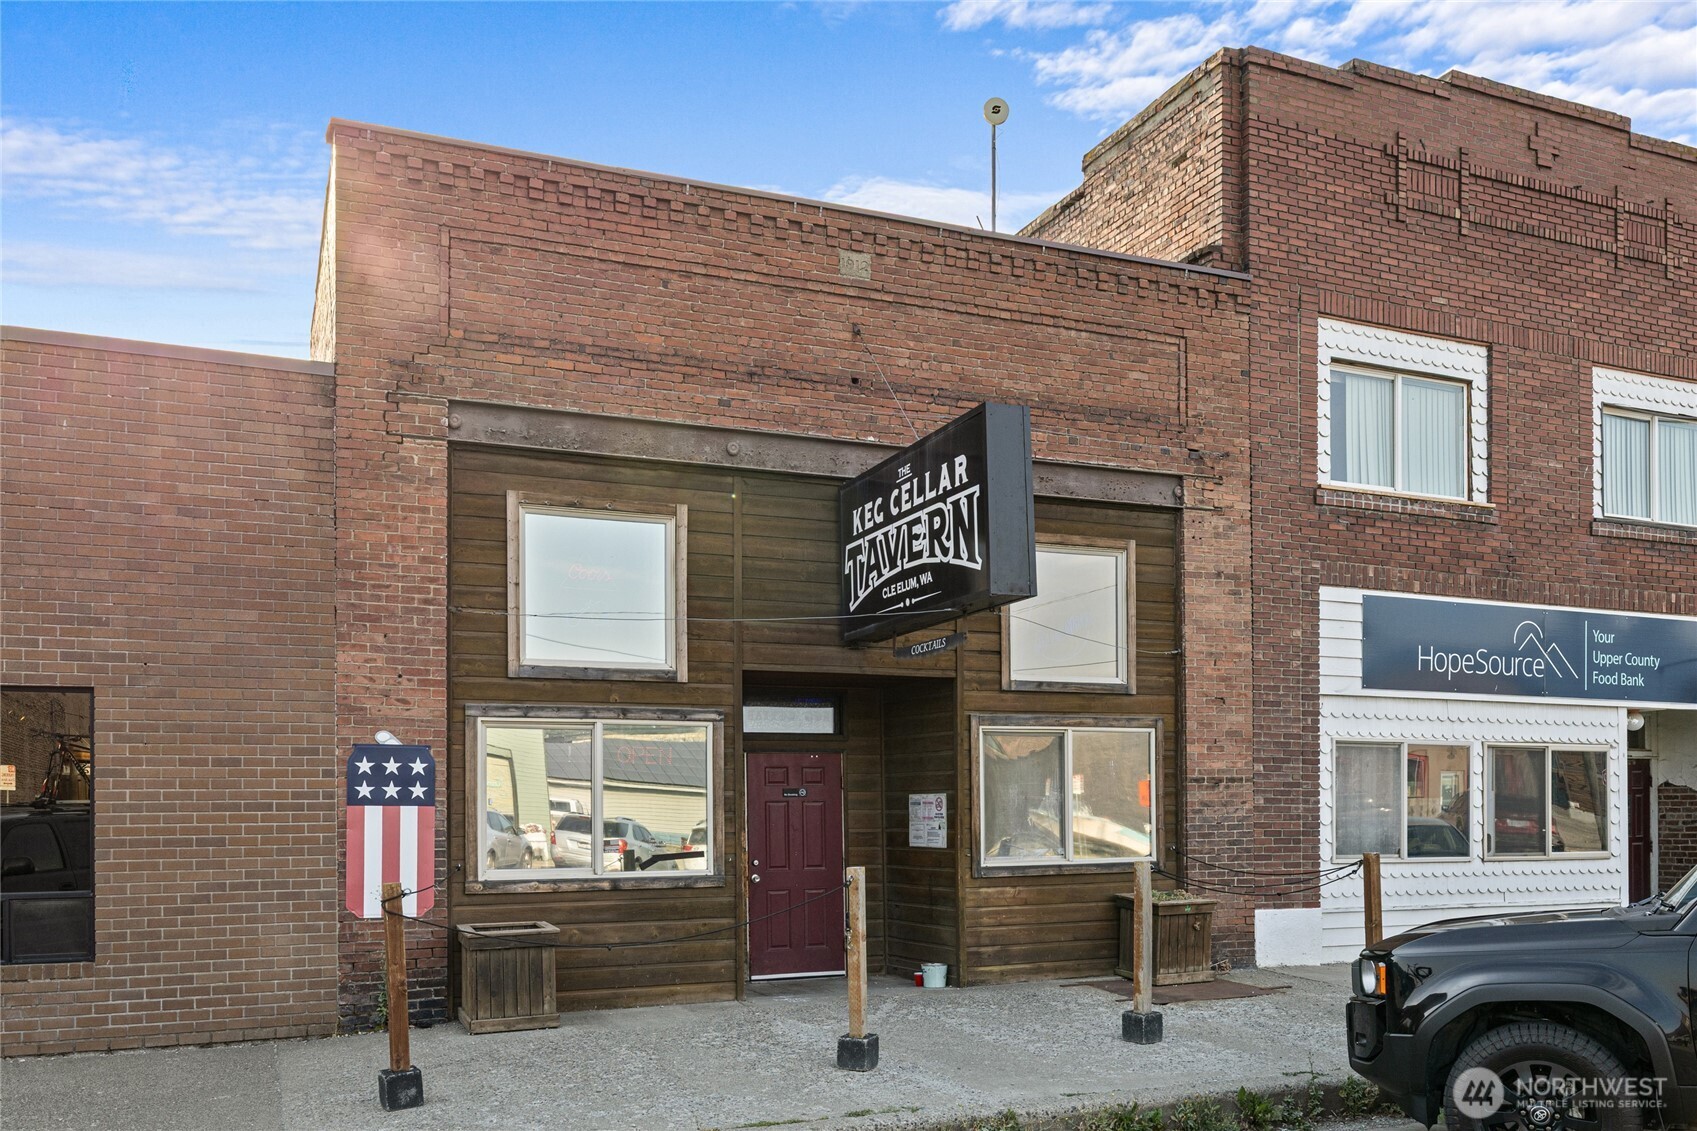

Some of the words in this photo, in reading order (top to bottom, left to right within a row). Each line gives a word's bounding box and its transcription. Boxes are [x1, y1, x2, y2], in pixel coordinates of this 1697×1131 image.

[898, 463, 911, 478] THE
[890, 454, 969, 516] CELLAR
[844, 484, 983, 613] TAVERN
[882, 583, 896, 599] CLE
[897, 577, 919, 594] ELUM,
[920, 571, 933, 585] WA
[911, 637, 947, 655] COCKTAILS
[1592, 629, 1615, 644] Your
[1418, 645, 1545, 681] HopeSource
[1593, 650, 1623, 669] Upper
[1625, 652, 1660, 670] County
[1593, 671, 1618, 685] Food
[1621, 672, 1645, 687] Bank
[616, 746, 673, 765] OPEN
